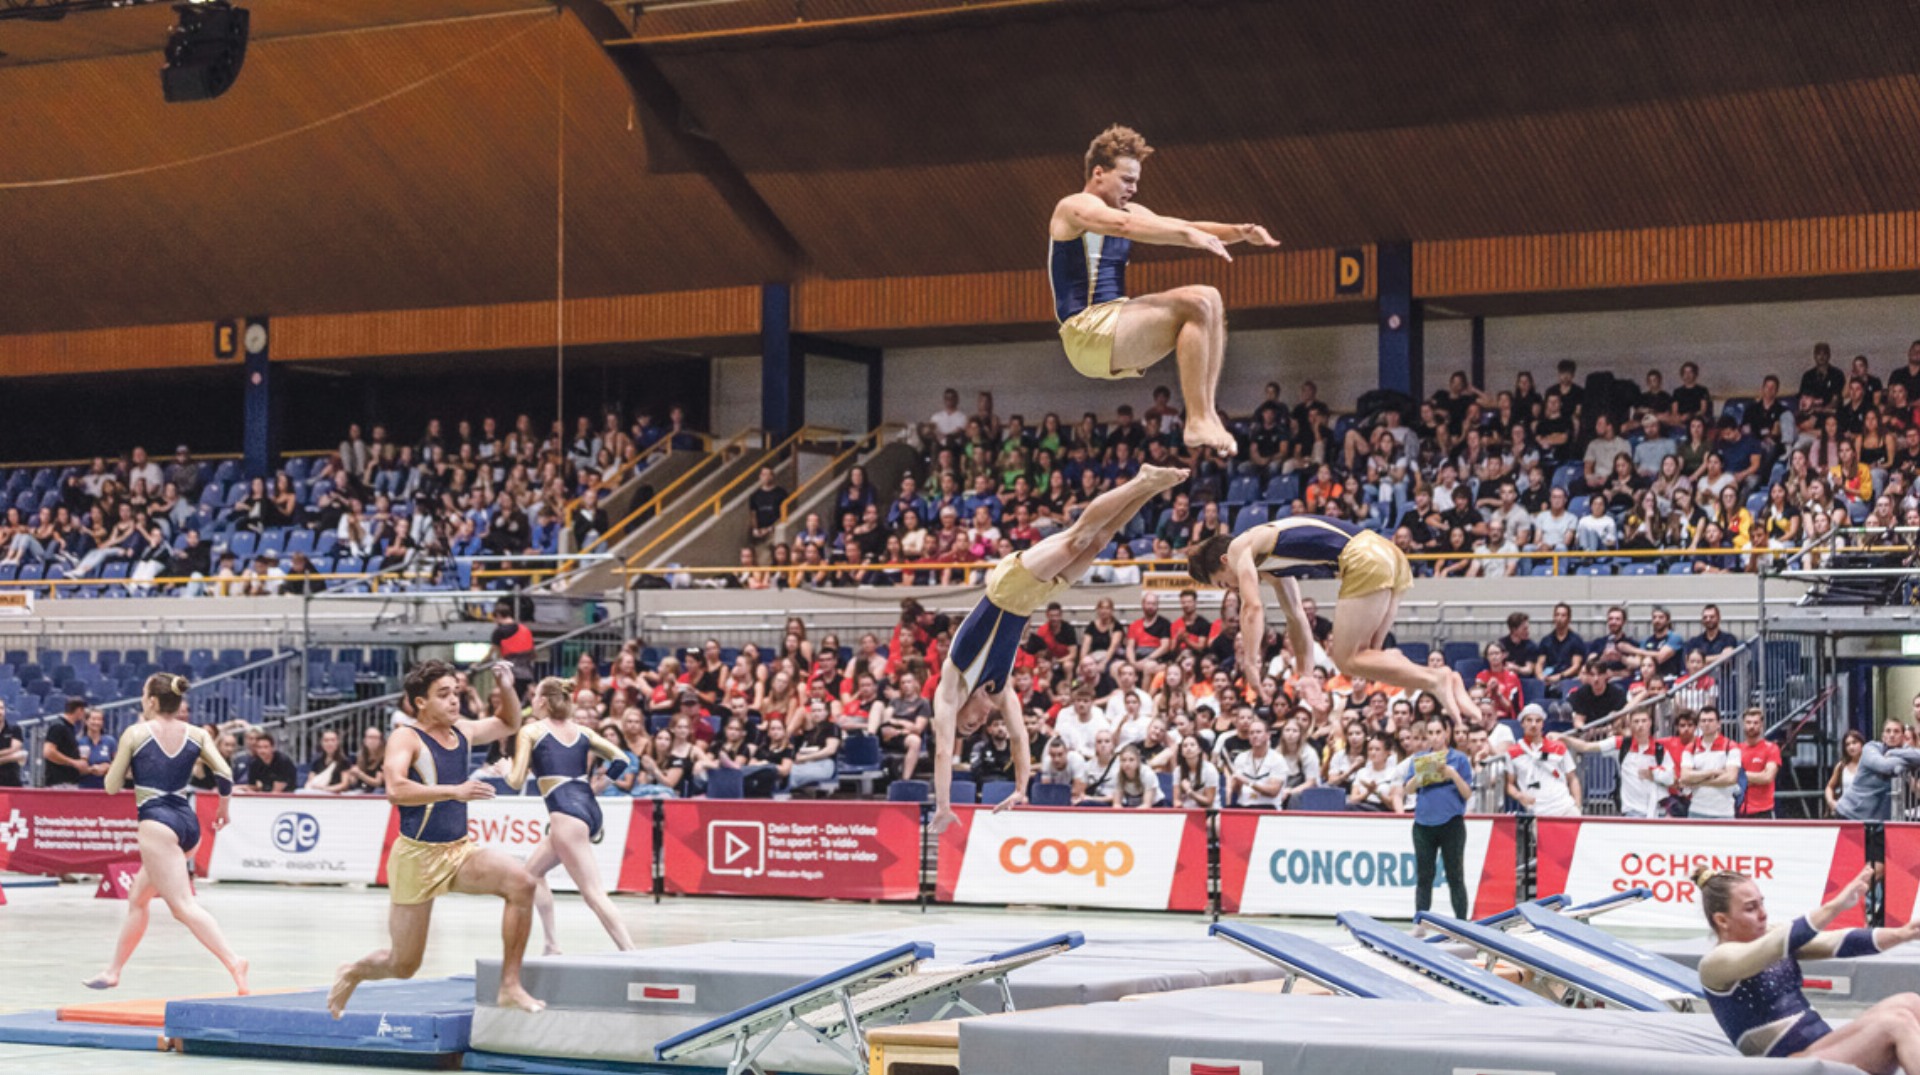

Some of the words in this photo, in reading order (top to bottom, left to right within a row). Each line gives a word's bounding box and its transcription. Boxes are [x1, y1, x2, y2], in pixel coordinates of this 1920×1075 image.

[1340, 256, 1360, 286] D
[220, 327, 232, 352] E
[768, 823, 790, 834] Dein
[791, 823, 818, 836] Sport
[825, 824, 848, 836] Dein
[849, 824, 878, 836] Video
[768, 836, 785, 847] Ton
[787, 837, 812, 849] sport
[819, 836, 831, 847] Ta
[775, 850, 791, 860] tuo
[792, 850, 818, 862] sport
[833, 851, 849, 861] tuo
[850, 850, 878, 862] video
[999, 836, 1135, 888] coop
